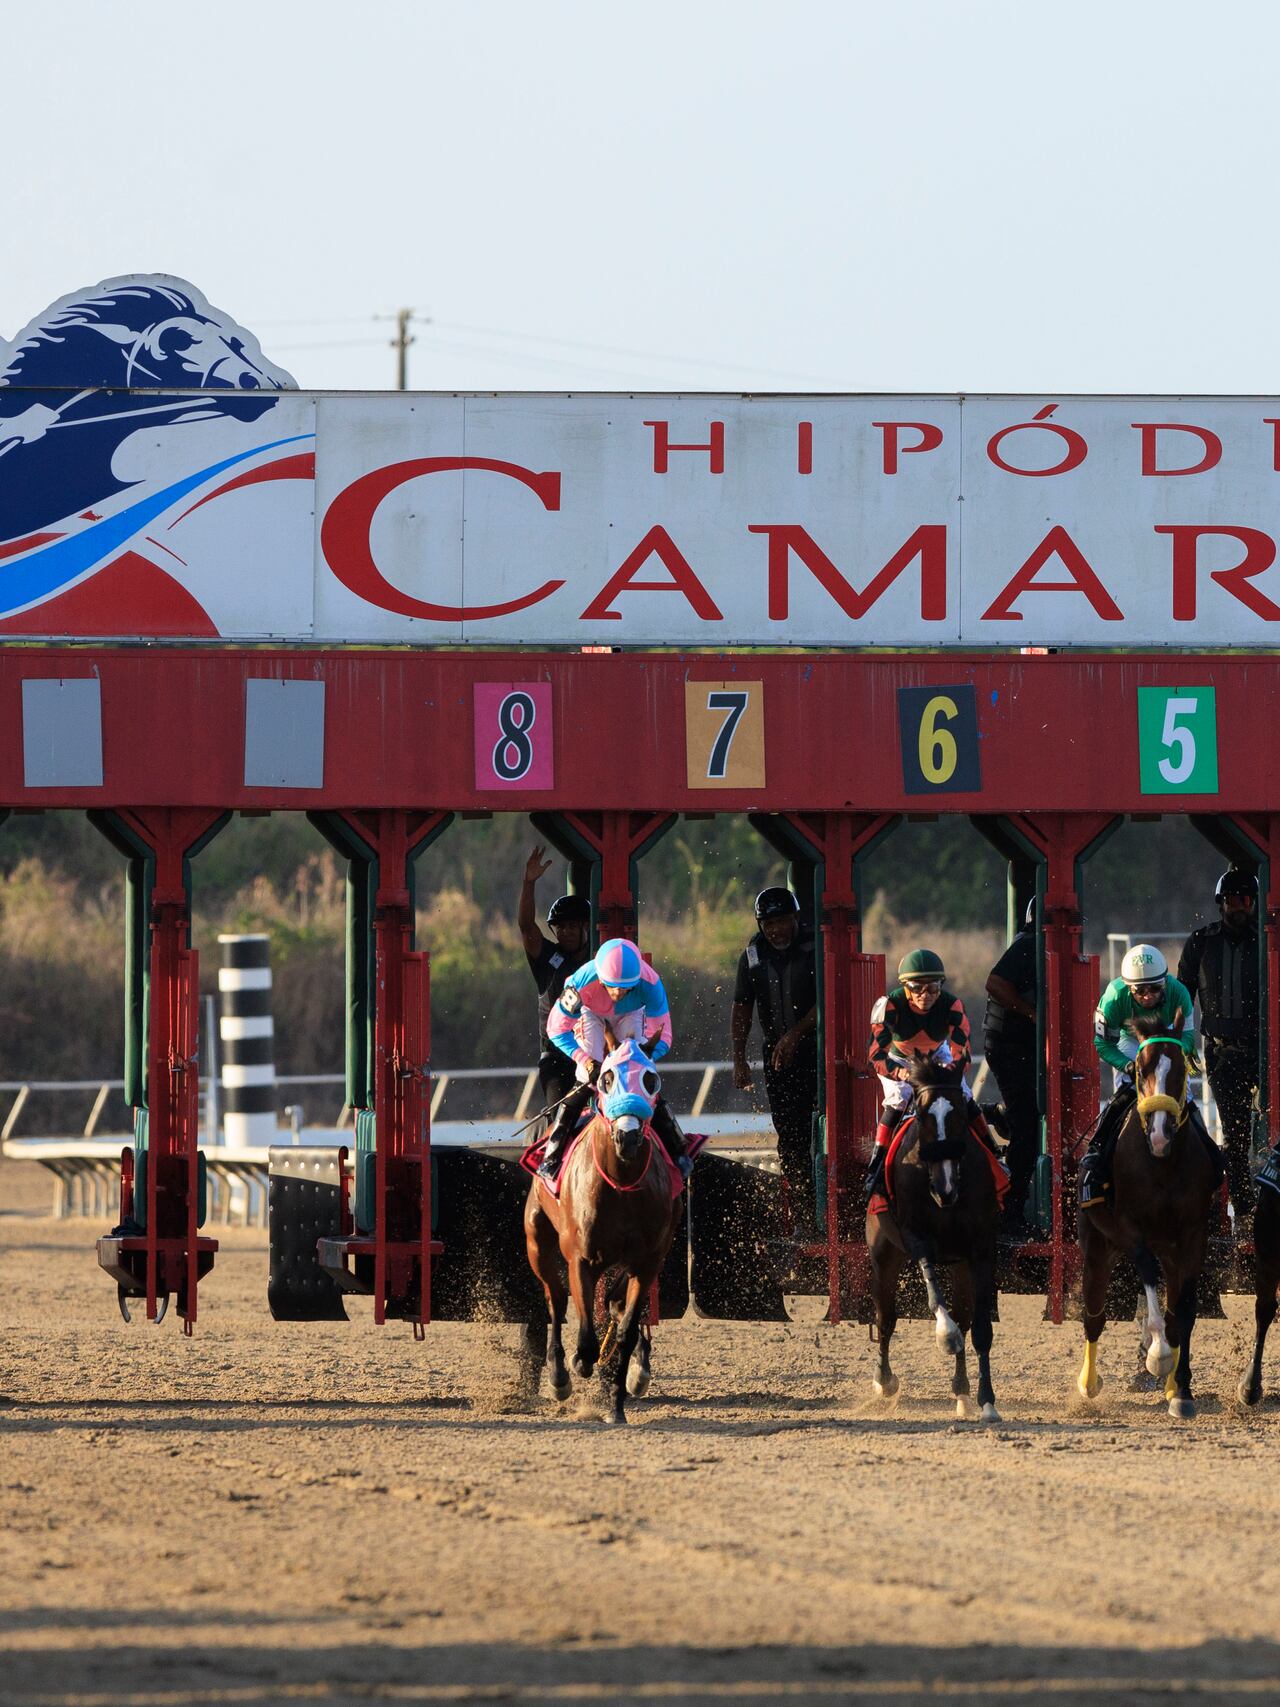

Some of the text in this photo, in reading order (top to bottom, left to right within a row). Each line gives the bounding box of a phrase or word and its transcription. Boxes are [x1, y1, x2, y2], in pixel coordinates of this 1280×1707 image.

[492, 691, 536, 781] 8
[706, 692, 748, 778] 7
[918, 695, 958, 784] 6
[1157, 697, 1199, 784] 5
[561, 988, 578, 1012] 8
